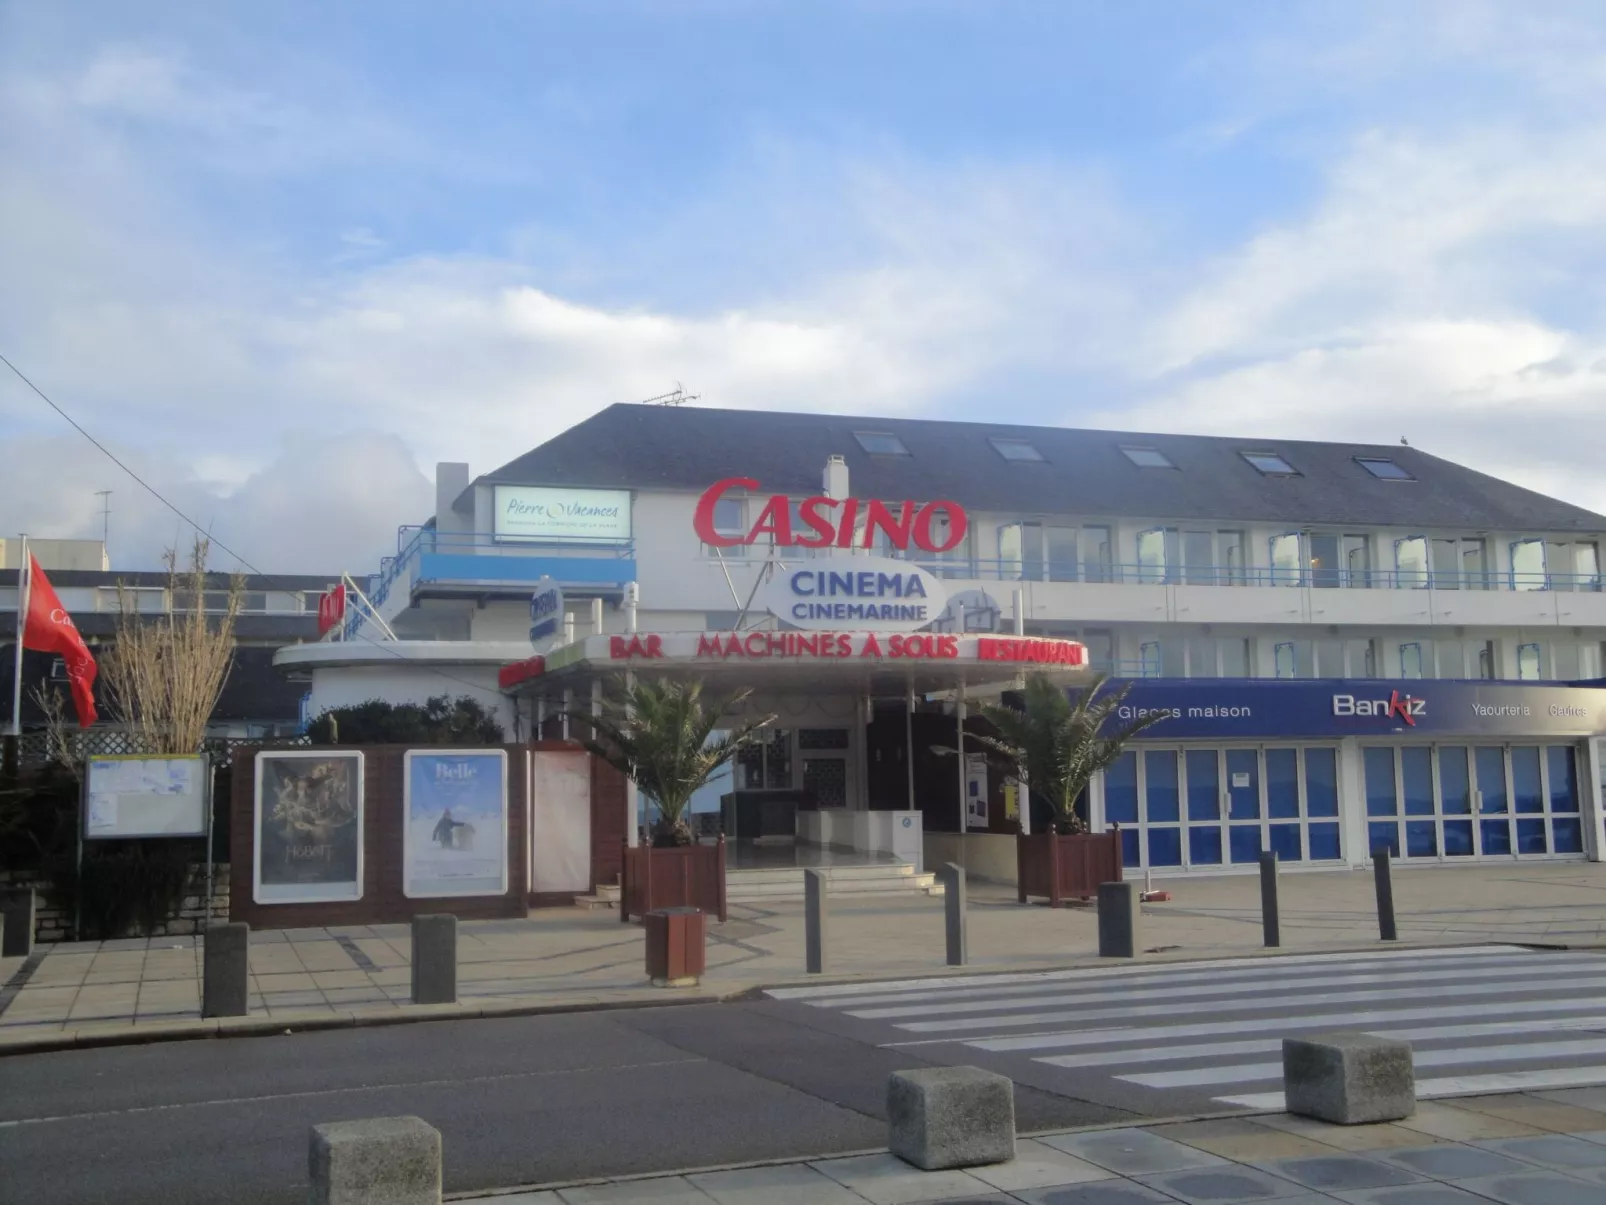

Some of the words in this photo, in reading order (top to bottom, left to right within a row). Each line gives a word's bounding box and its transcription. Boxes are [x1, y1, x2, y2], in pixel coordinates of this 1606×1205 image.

[507, 498, 544, 515] Pierre
[566, 500, 619, 518] Vacances
[693, 477, 968, 553] CASINO
[790, 570, 928, 598] CINEMA
[792, 603, 928, 621] CINEMARINE
[609, 633, 663, 659] BAR
[697, 632, 852, 658] MACHINES
[888, 634, 959, 659] SOUS
[1188, 705, 1251, 718] maison
[1333, 689, 1426, 726] Bankiz
[1472, 703, 1531, 717] Yaourteria
[436, 763, 477, 779] Belle
